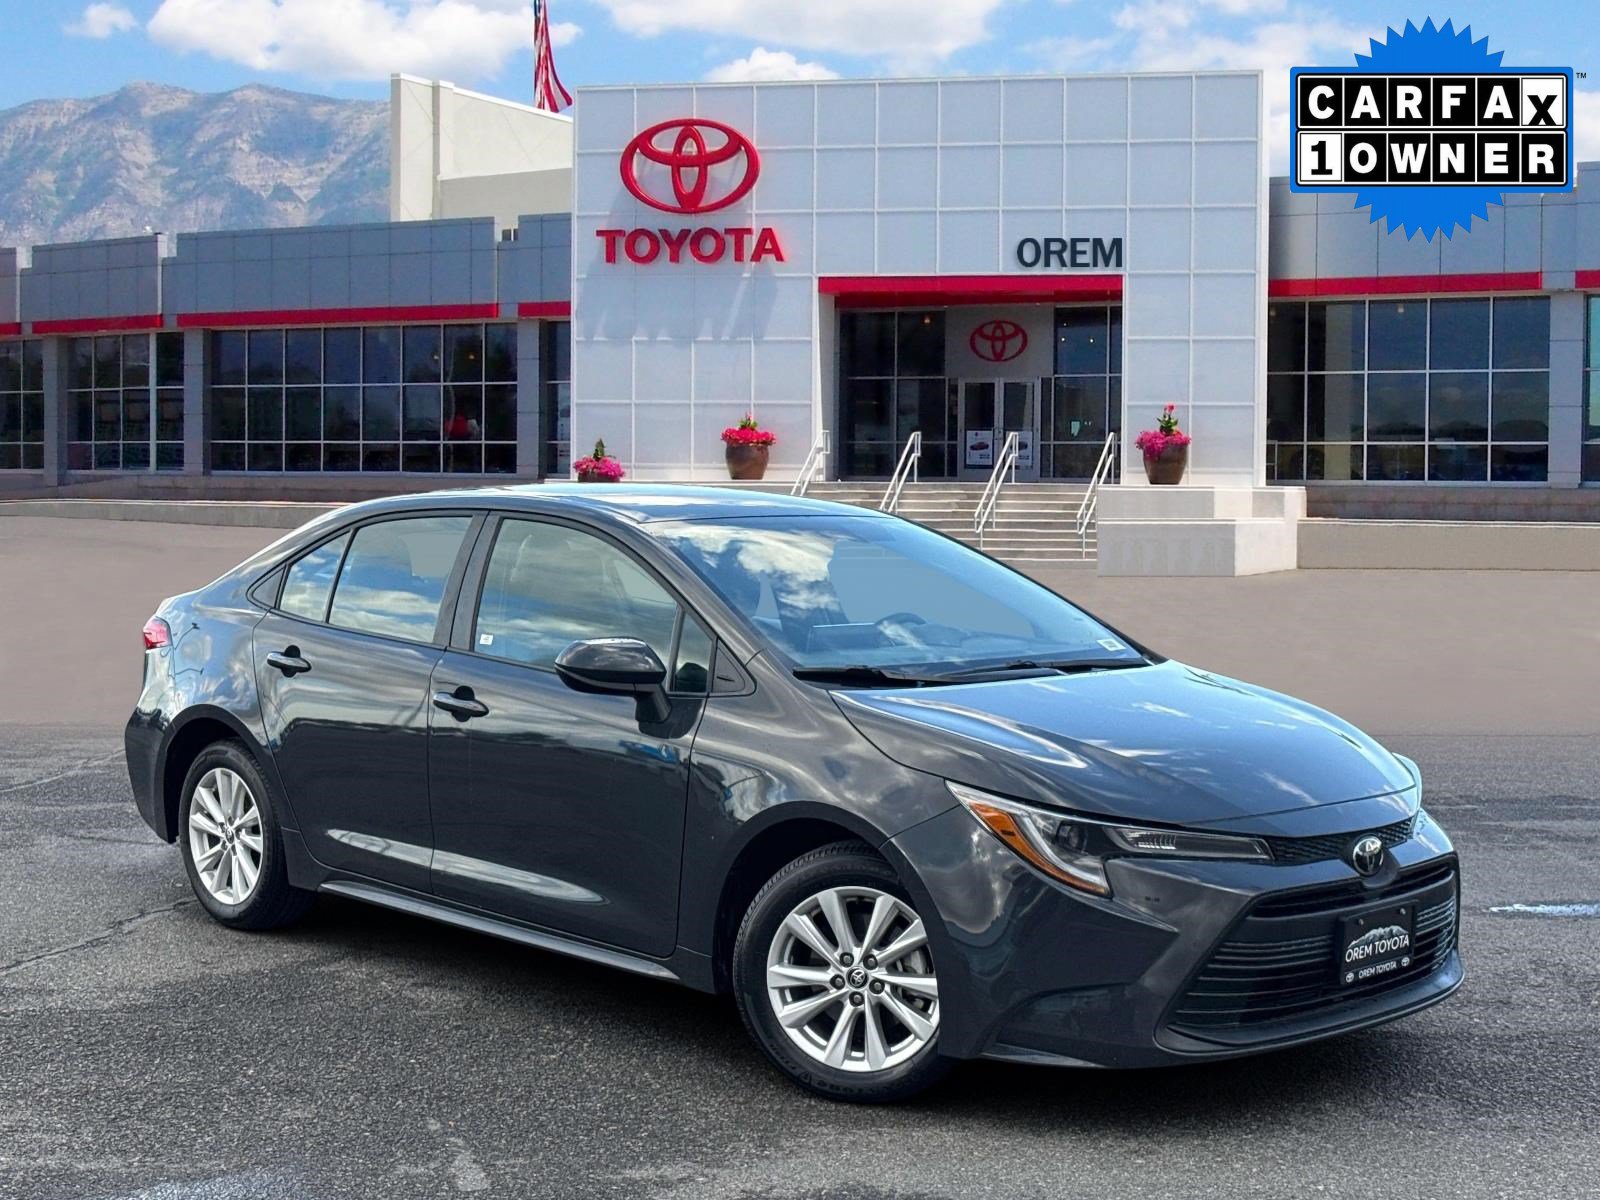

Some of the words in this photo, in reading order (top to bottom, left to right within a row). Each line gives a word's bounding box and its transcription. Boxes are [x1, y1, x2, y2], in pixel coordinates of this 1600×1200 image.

[596, 227, 784, 264] TOYOTA
[1017, 238, 1123, 267] OREM
[1345, 943, 1373, 963] OREM
[1374, 934, 1410, 955] TOYOTA
[1358, 967, 1376, 979] OREM
[1376, 961, 1397, 975] TOYOTA
